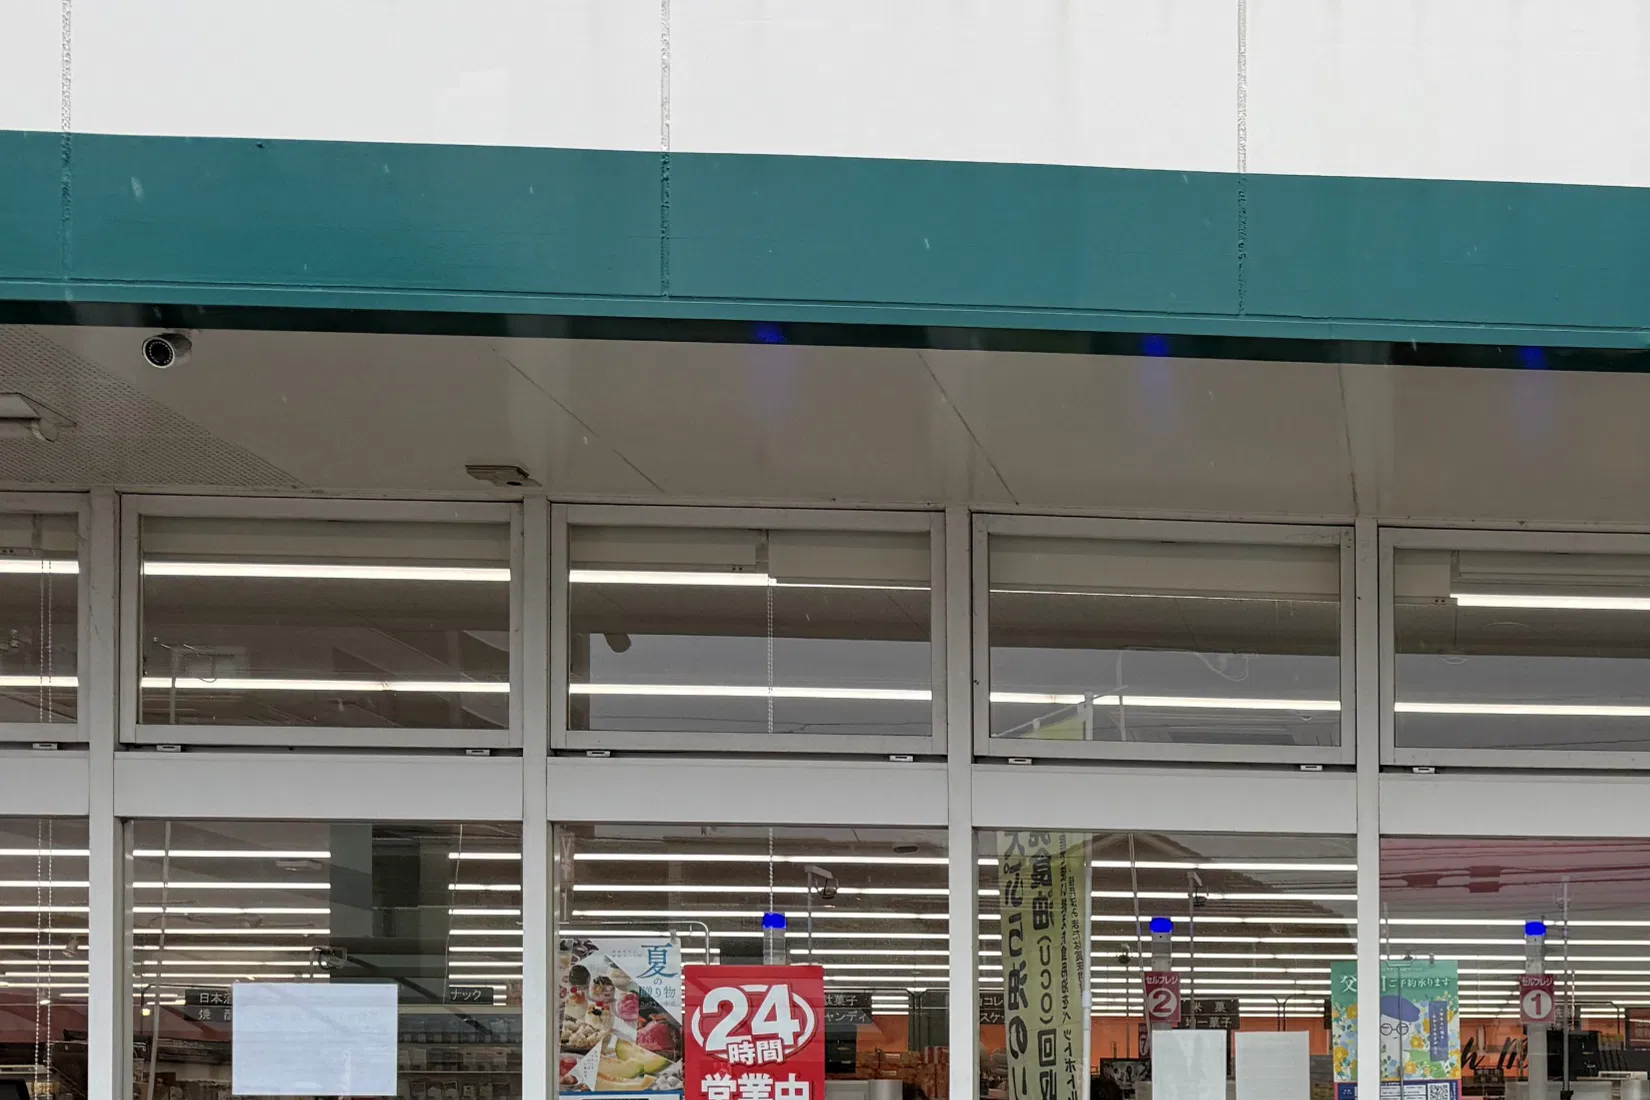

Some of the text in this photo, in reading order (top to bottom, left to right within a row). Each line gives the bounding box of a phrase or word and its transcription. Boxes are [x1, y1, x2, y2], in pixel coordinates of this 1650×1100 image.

[636, 943, 678, 978] 夏
[1145, 975, 1179, 985] セルフレジ
[1522, 976, 1553, 987] セルフレジ
[1152, 990, 1172, 1013] 2
[1531, 992, 1542, 1016] 1
[702, 984, 800, 1051] 24
[728, 1039, 784, 1065] 時間
